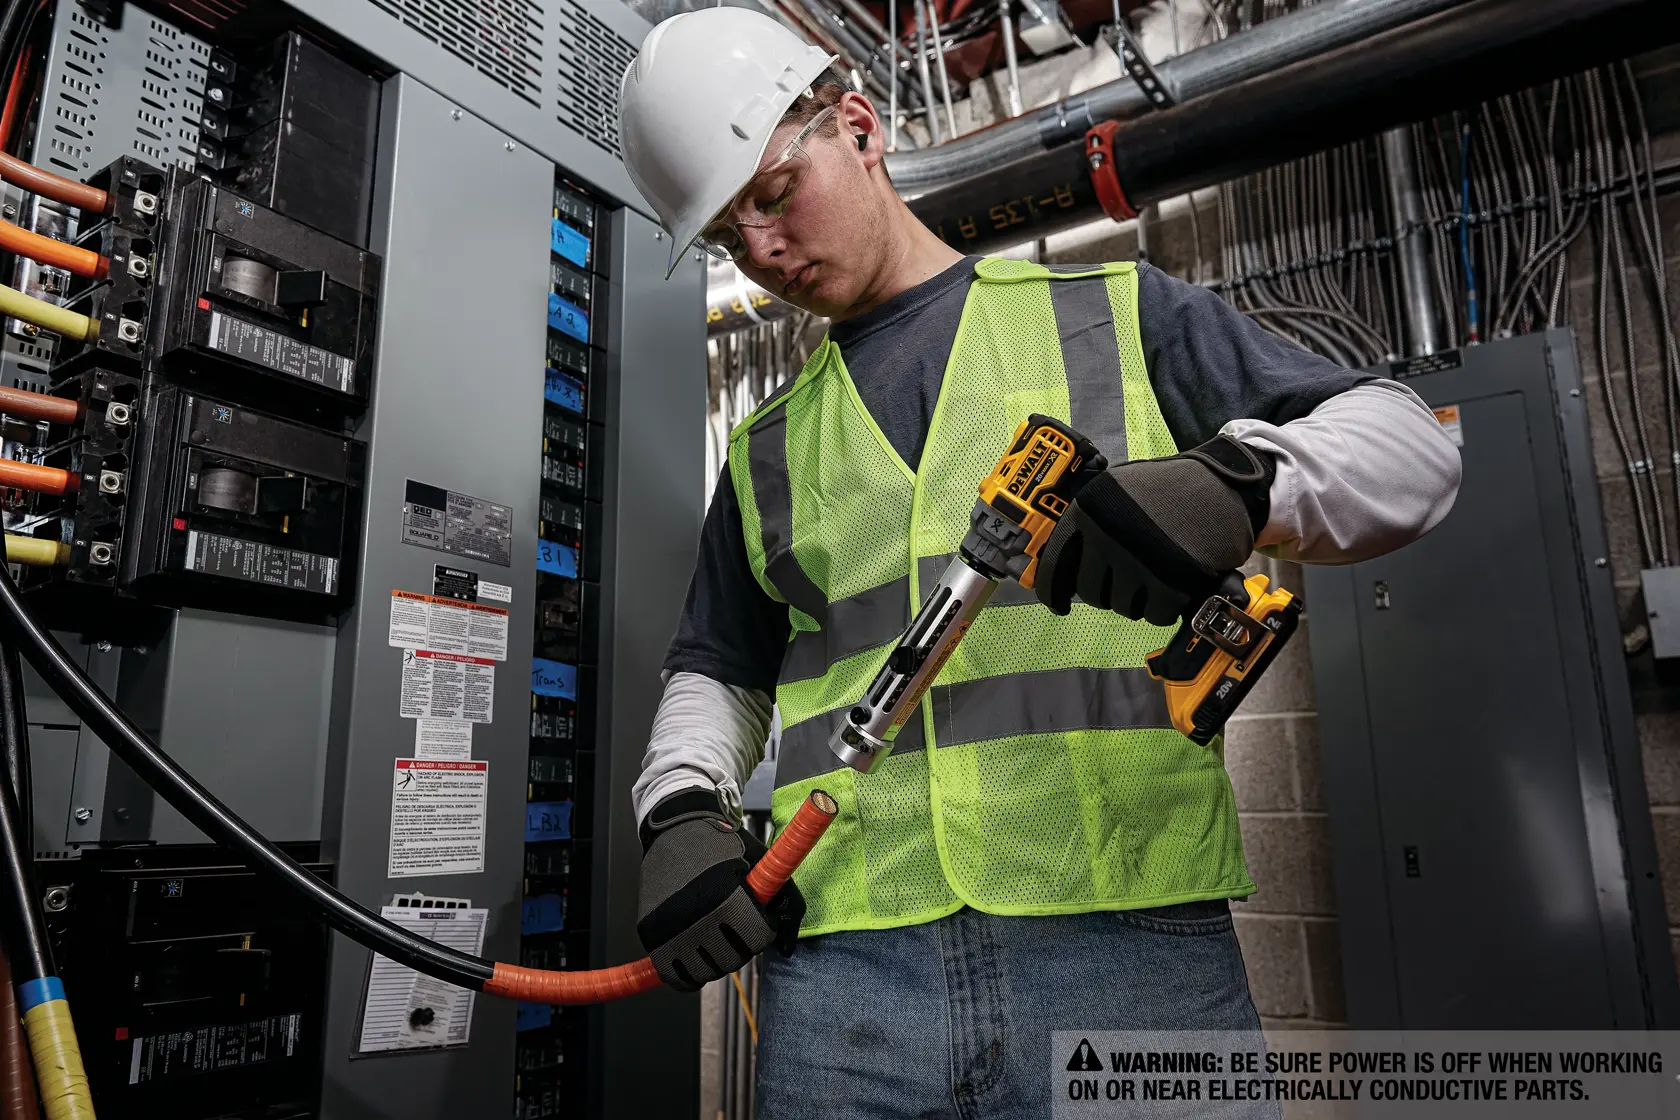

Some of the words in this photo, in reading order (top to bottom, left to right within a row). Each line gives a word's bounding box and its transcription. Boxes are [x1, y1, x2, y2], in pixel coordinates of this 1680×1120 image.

[1007, 442, 1048, 497] DEWALT
[403, 592, 425, 601] WARNING
[437, 599, 468, 608] ADVERTENCIA
[532, 668, 565, 688] Trans
[528, 812, 562, 832] LB2
